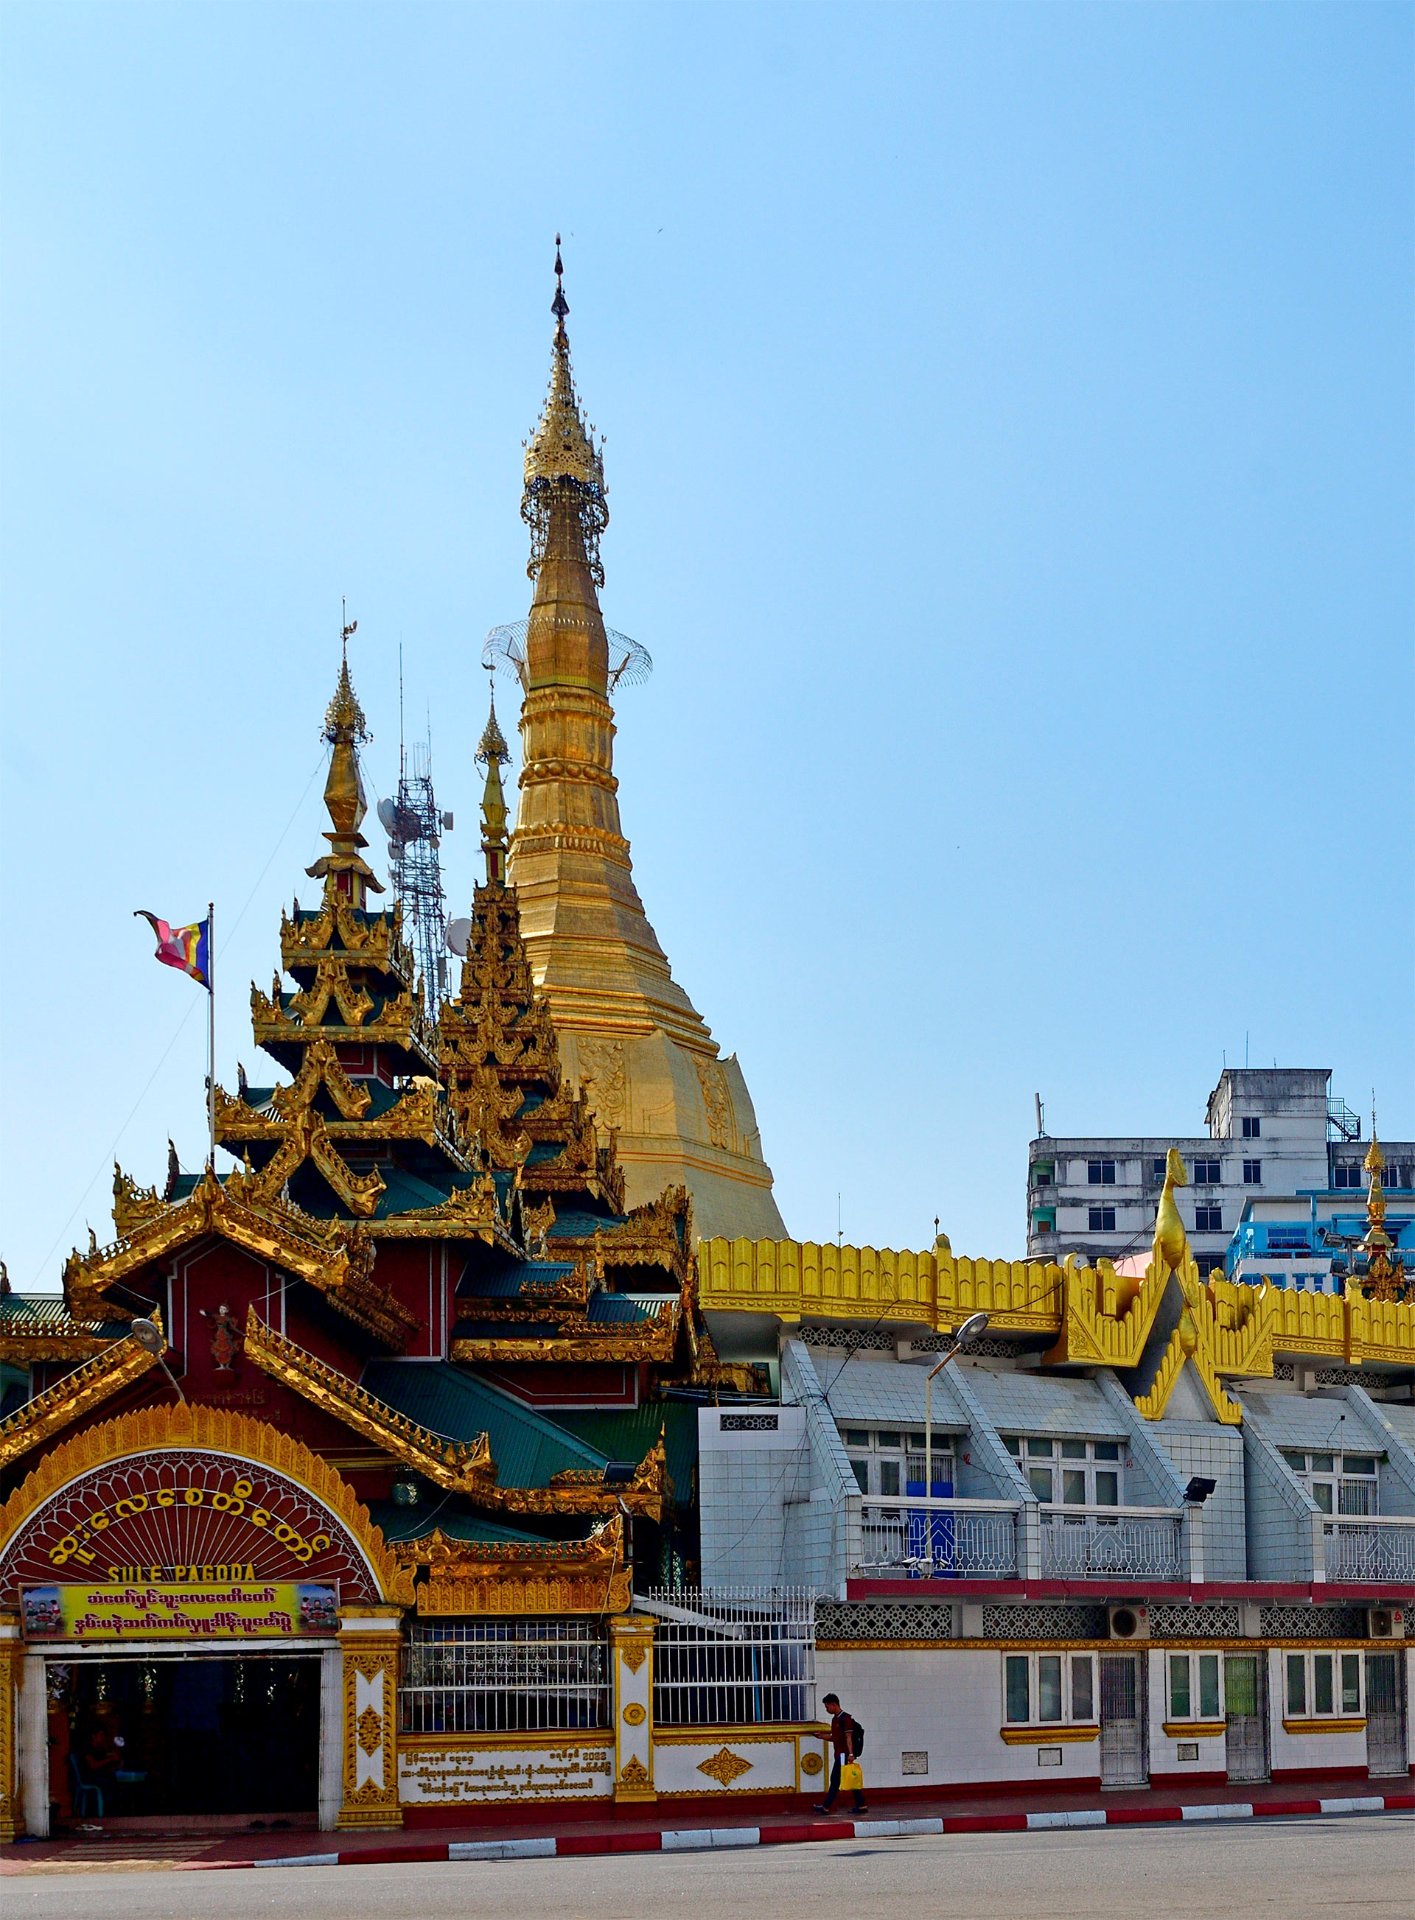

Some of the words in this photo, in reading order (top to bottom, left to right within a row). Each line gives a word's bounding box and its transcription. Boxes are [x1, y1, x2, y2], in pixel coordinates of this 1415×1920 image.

[49, 1480, 331, 1565] ဆူးလေစေတီတော်
[108, 1565, 162, 1582] SULE
[175, 1563, 257, 1582] PAGODA
[582, 1751, 607, 1761] 2022
